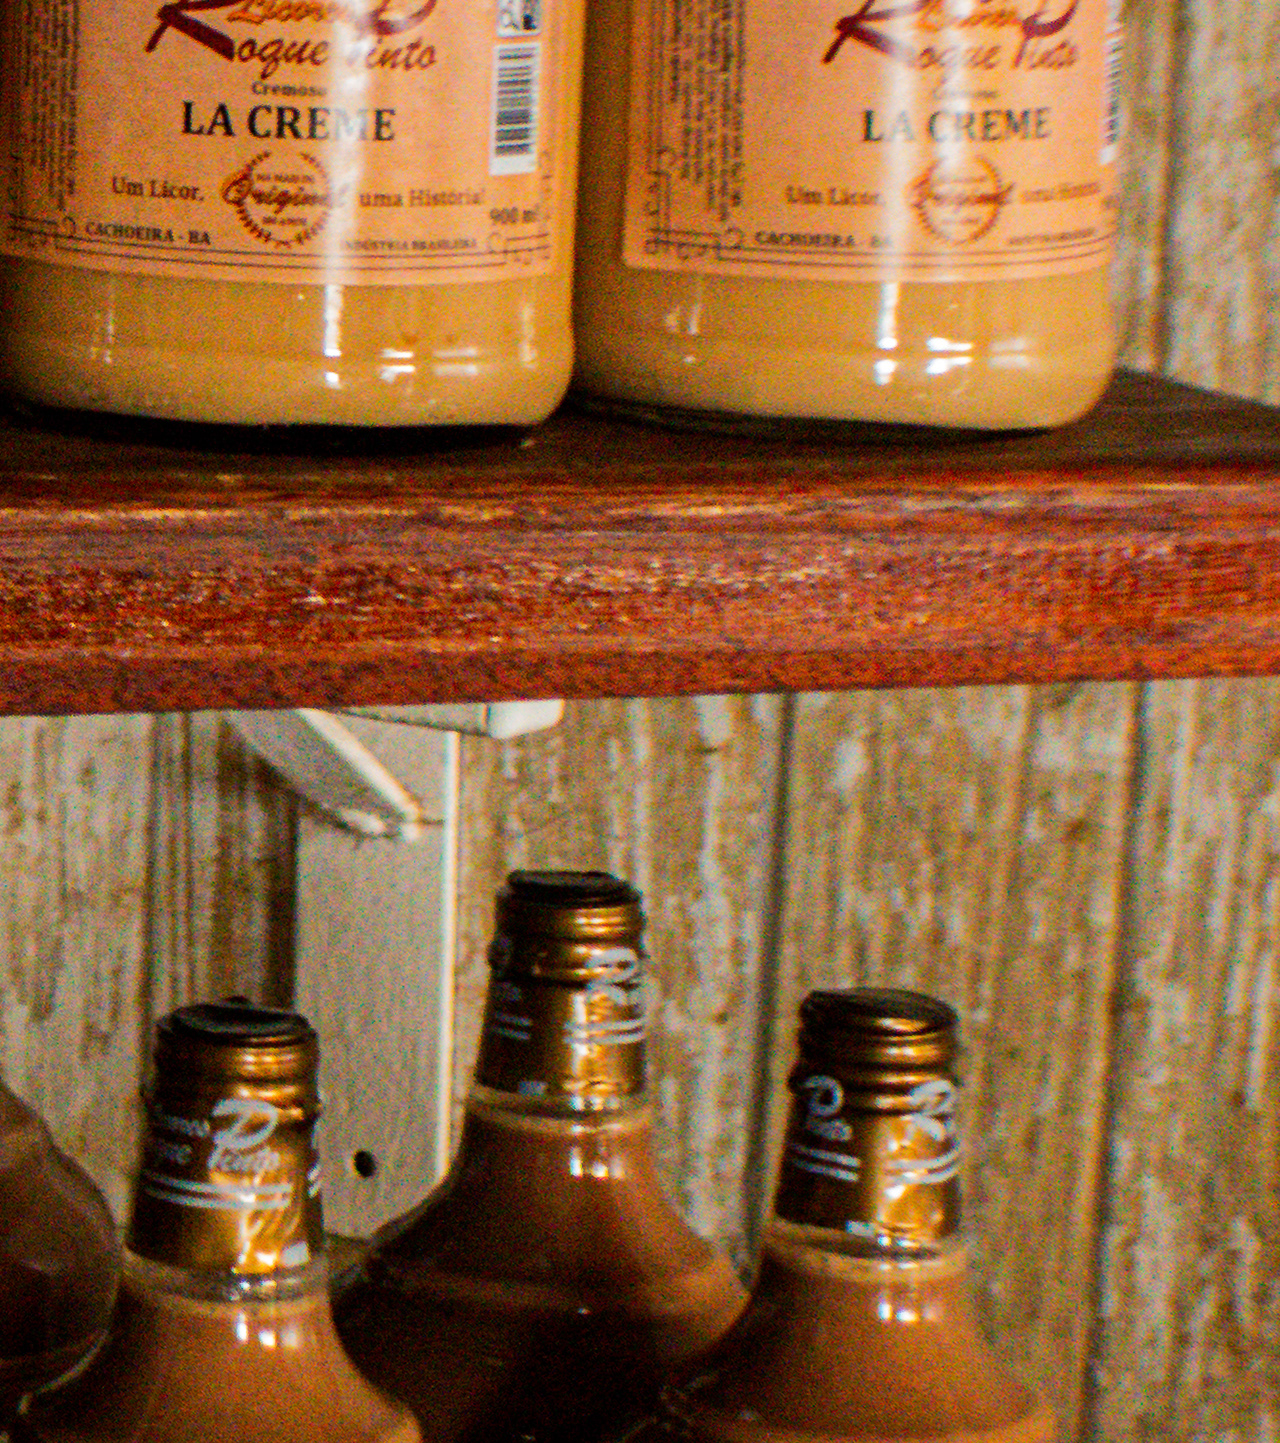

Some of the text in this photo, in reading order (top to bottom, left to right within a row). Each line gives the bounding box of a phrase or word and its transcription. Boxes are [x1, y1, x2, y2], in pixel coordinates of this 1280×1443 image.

[181, 100, 395, 142] LA CREME
[863, 107, 1050, 142] LA CREME
[111, 177, 145, 197] Um
[360, 192, 402, 207] uma
[410, 188, 484, 207] História!
[85, 222, 211, 245] CACHOEIRA BA
